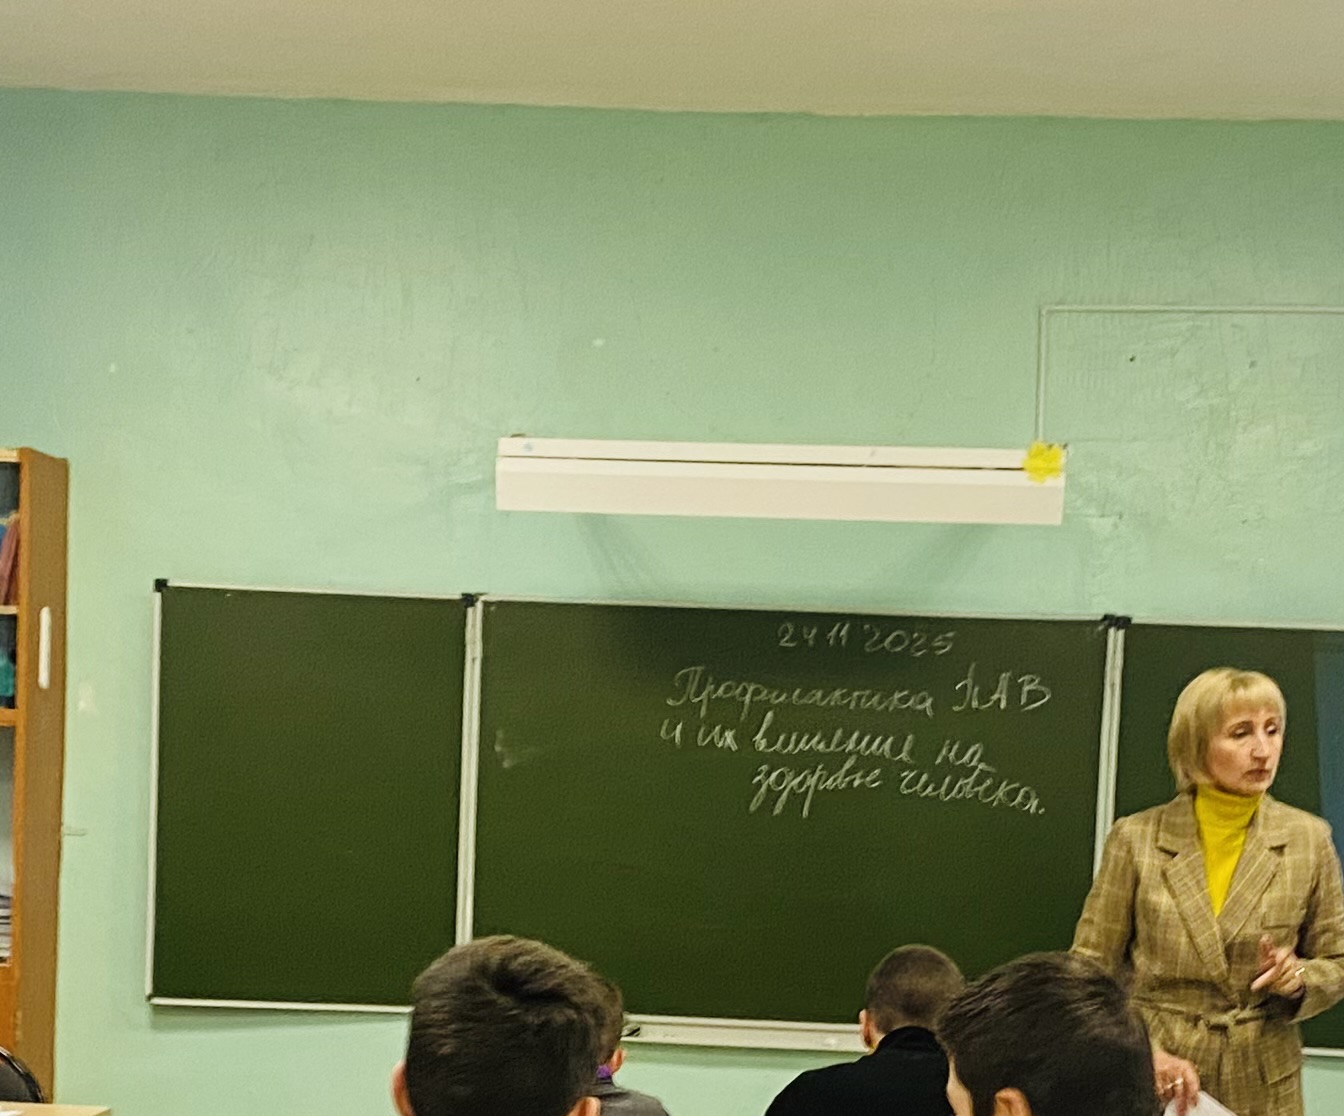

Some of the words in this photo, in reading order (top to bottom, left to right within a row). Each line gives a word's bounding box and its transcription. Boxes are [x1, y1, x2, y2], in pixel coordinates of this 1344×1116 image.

[665, 664, 935, 721] Профилактика
[952, 661, 1053, 712] ПАВ
[659, 717, 684, 749] и
[696, 723, 738, 752] их
[751, 709, 914, 765] влияние
[934, 739, 984, 767] на
